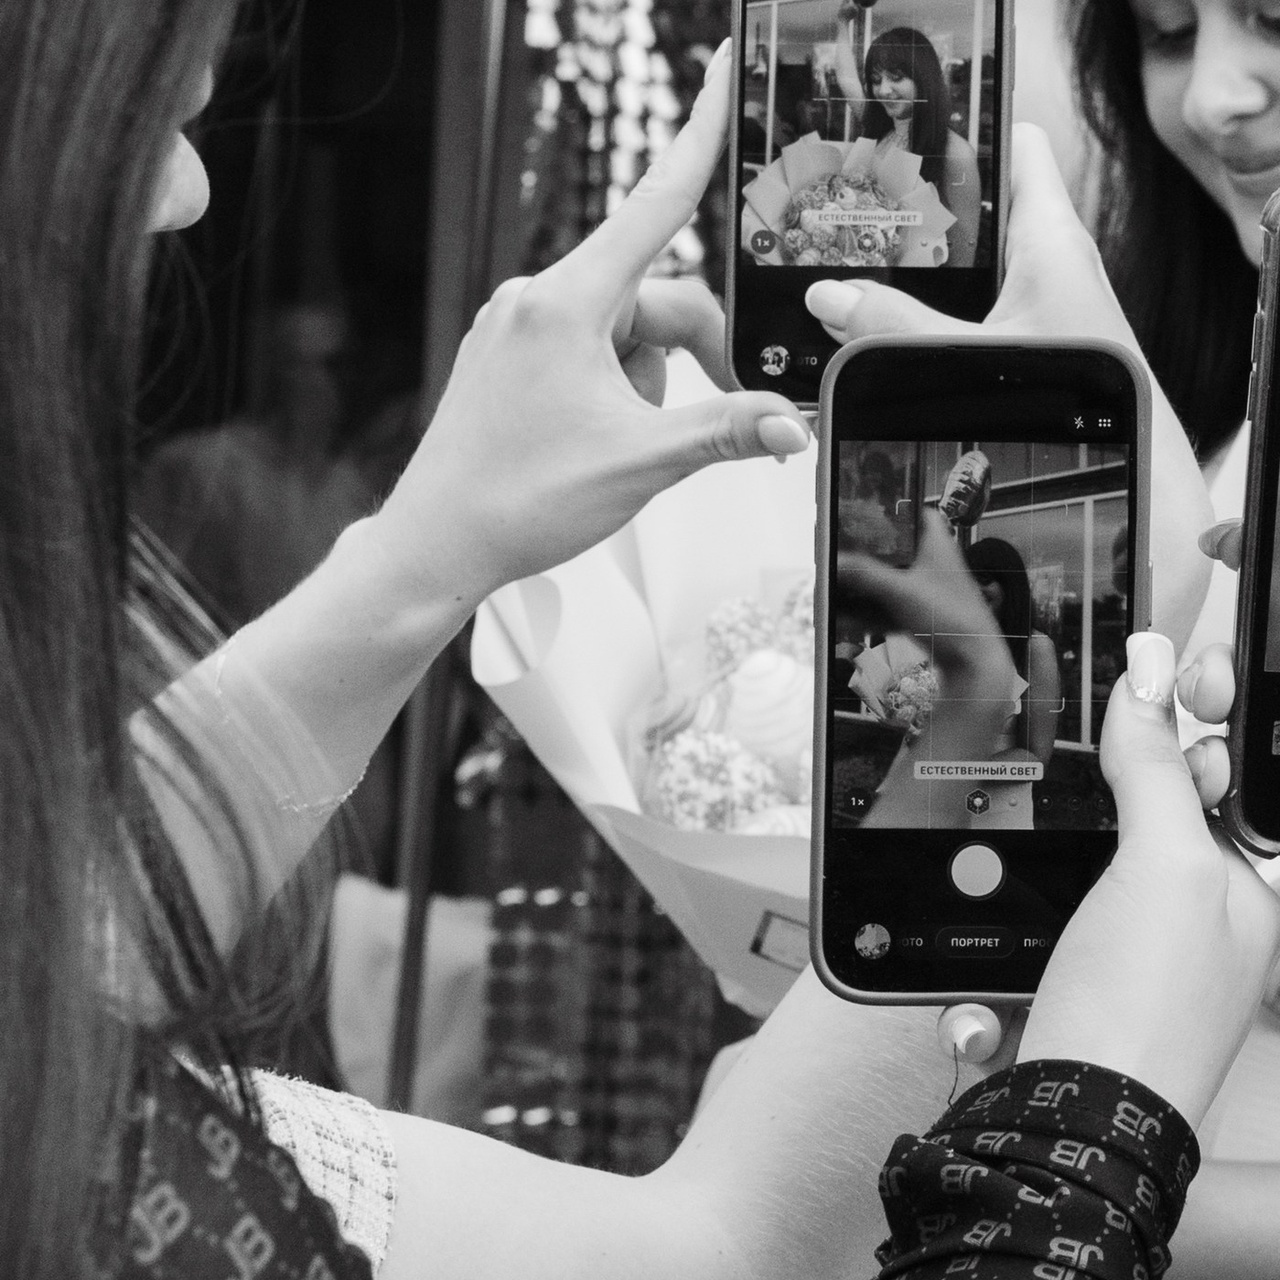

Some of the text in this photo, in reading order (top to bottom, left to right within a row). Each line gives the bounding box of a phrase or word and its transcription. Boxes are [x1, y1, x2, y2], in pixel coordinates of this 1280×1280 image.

[818, 213, 918, 223] ЕСТЕСТВЕННЫЙ СВЕТ
[920, 765, 1037, 776] ЕСТЕСТВЕННЫЙ СВЕТ
[951, 938, 1000, 947] ПОРТРЕТ
